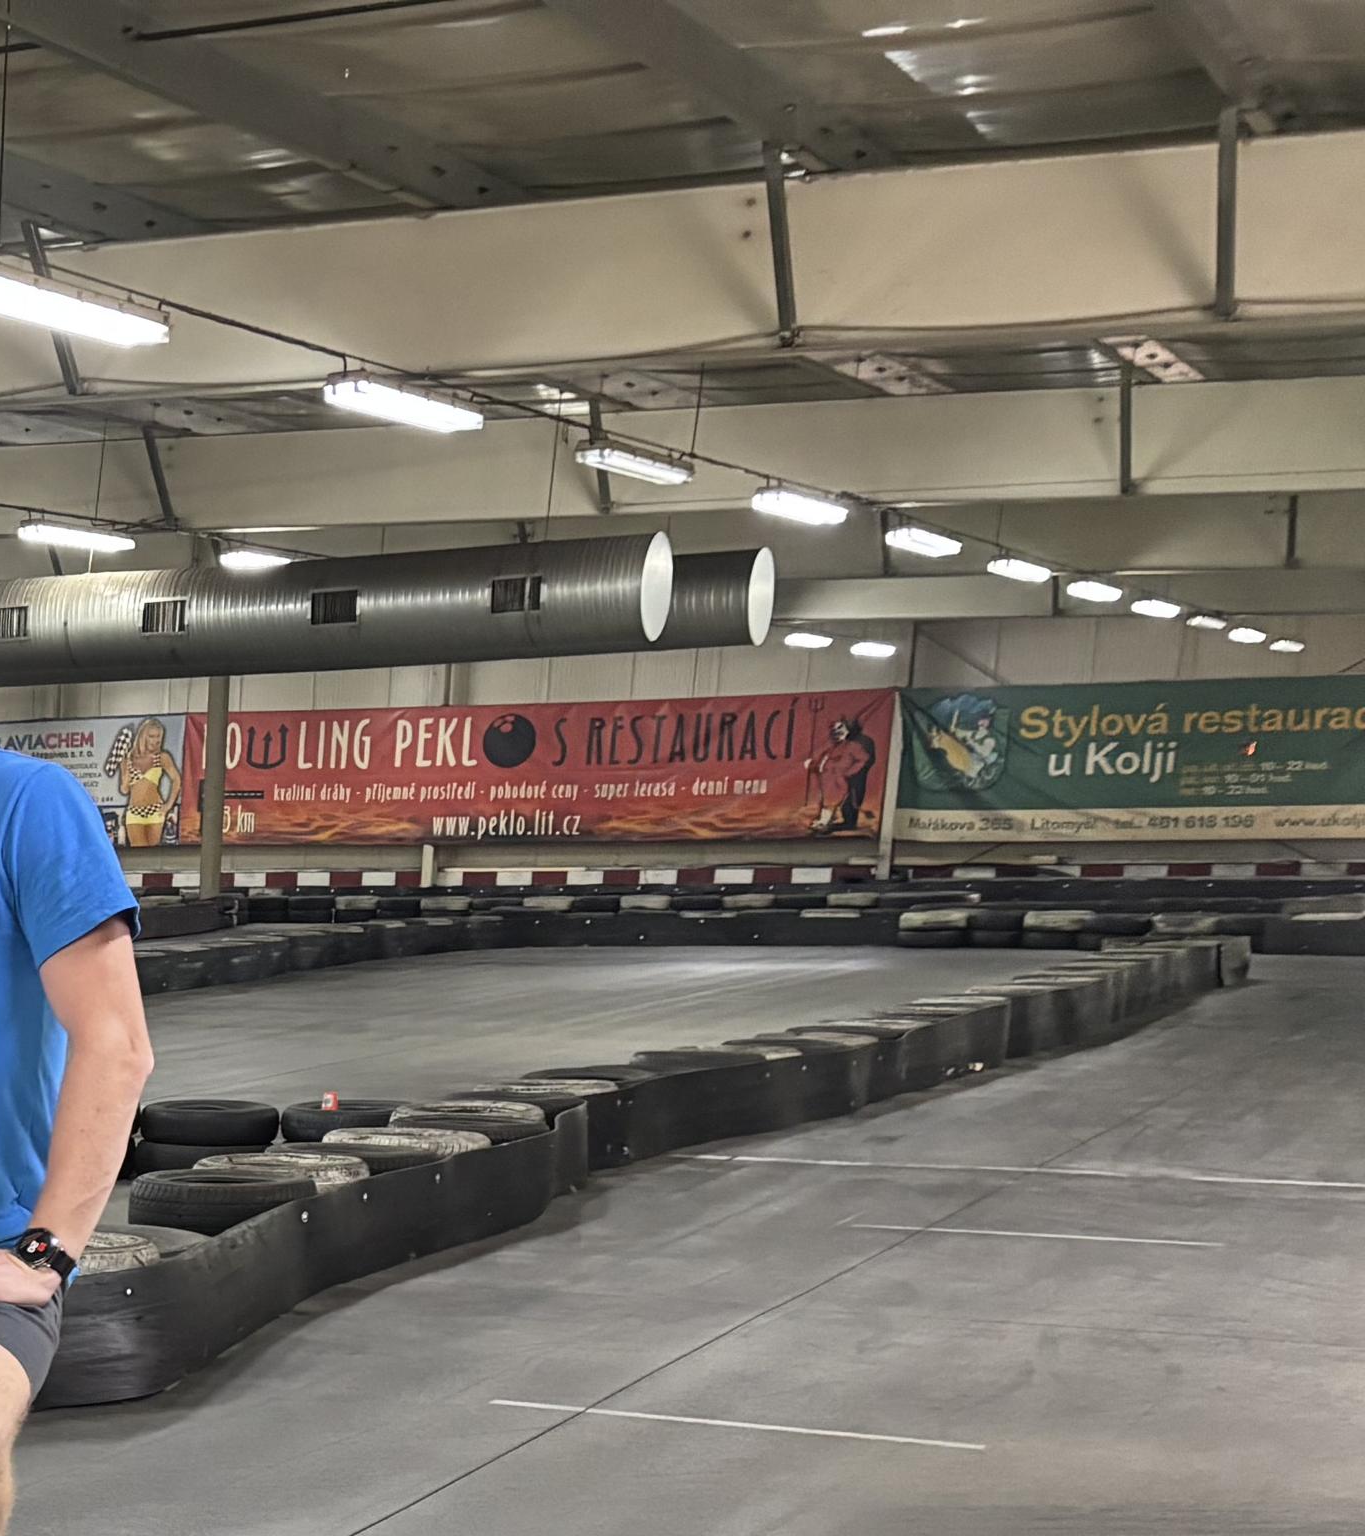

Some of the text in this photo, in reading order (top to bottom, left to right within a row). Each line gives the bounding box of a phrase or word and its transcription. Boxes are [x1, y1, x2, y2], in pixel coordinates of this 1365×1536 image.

[552, 697, 800, 767] S RESTAURACÍ
[1020, 703, 1168, 747] Stylová
[1048, 754, 1072, 776] u
[1085, 741, 1178, 783] Kolji
[274, 783, 317, 801] kvalitní
[320, 783, 351, 803] dráhy
[365, 782, 416, 803] příjemné
[420, 781, 476, 803] prostředí
[489, 780, 547, 801] pohodové
[551, 784, 579, 801] ceny
[594, 782, 629, 800] super
[634, 779, 676, 797] terasa
[692, 776, 729, 796] denní
[733, 779, 767, 795] menu
[237, 806, 255, 833] km
[432, 809, 581, 840] www.peklo.lit.cz
